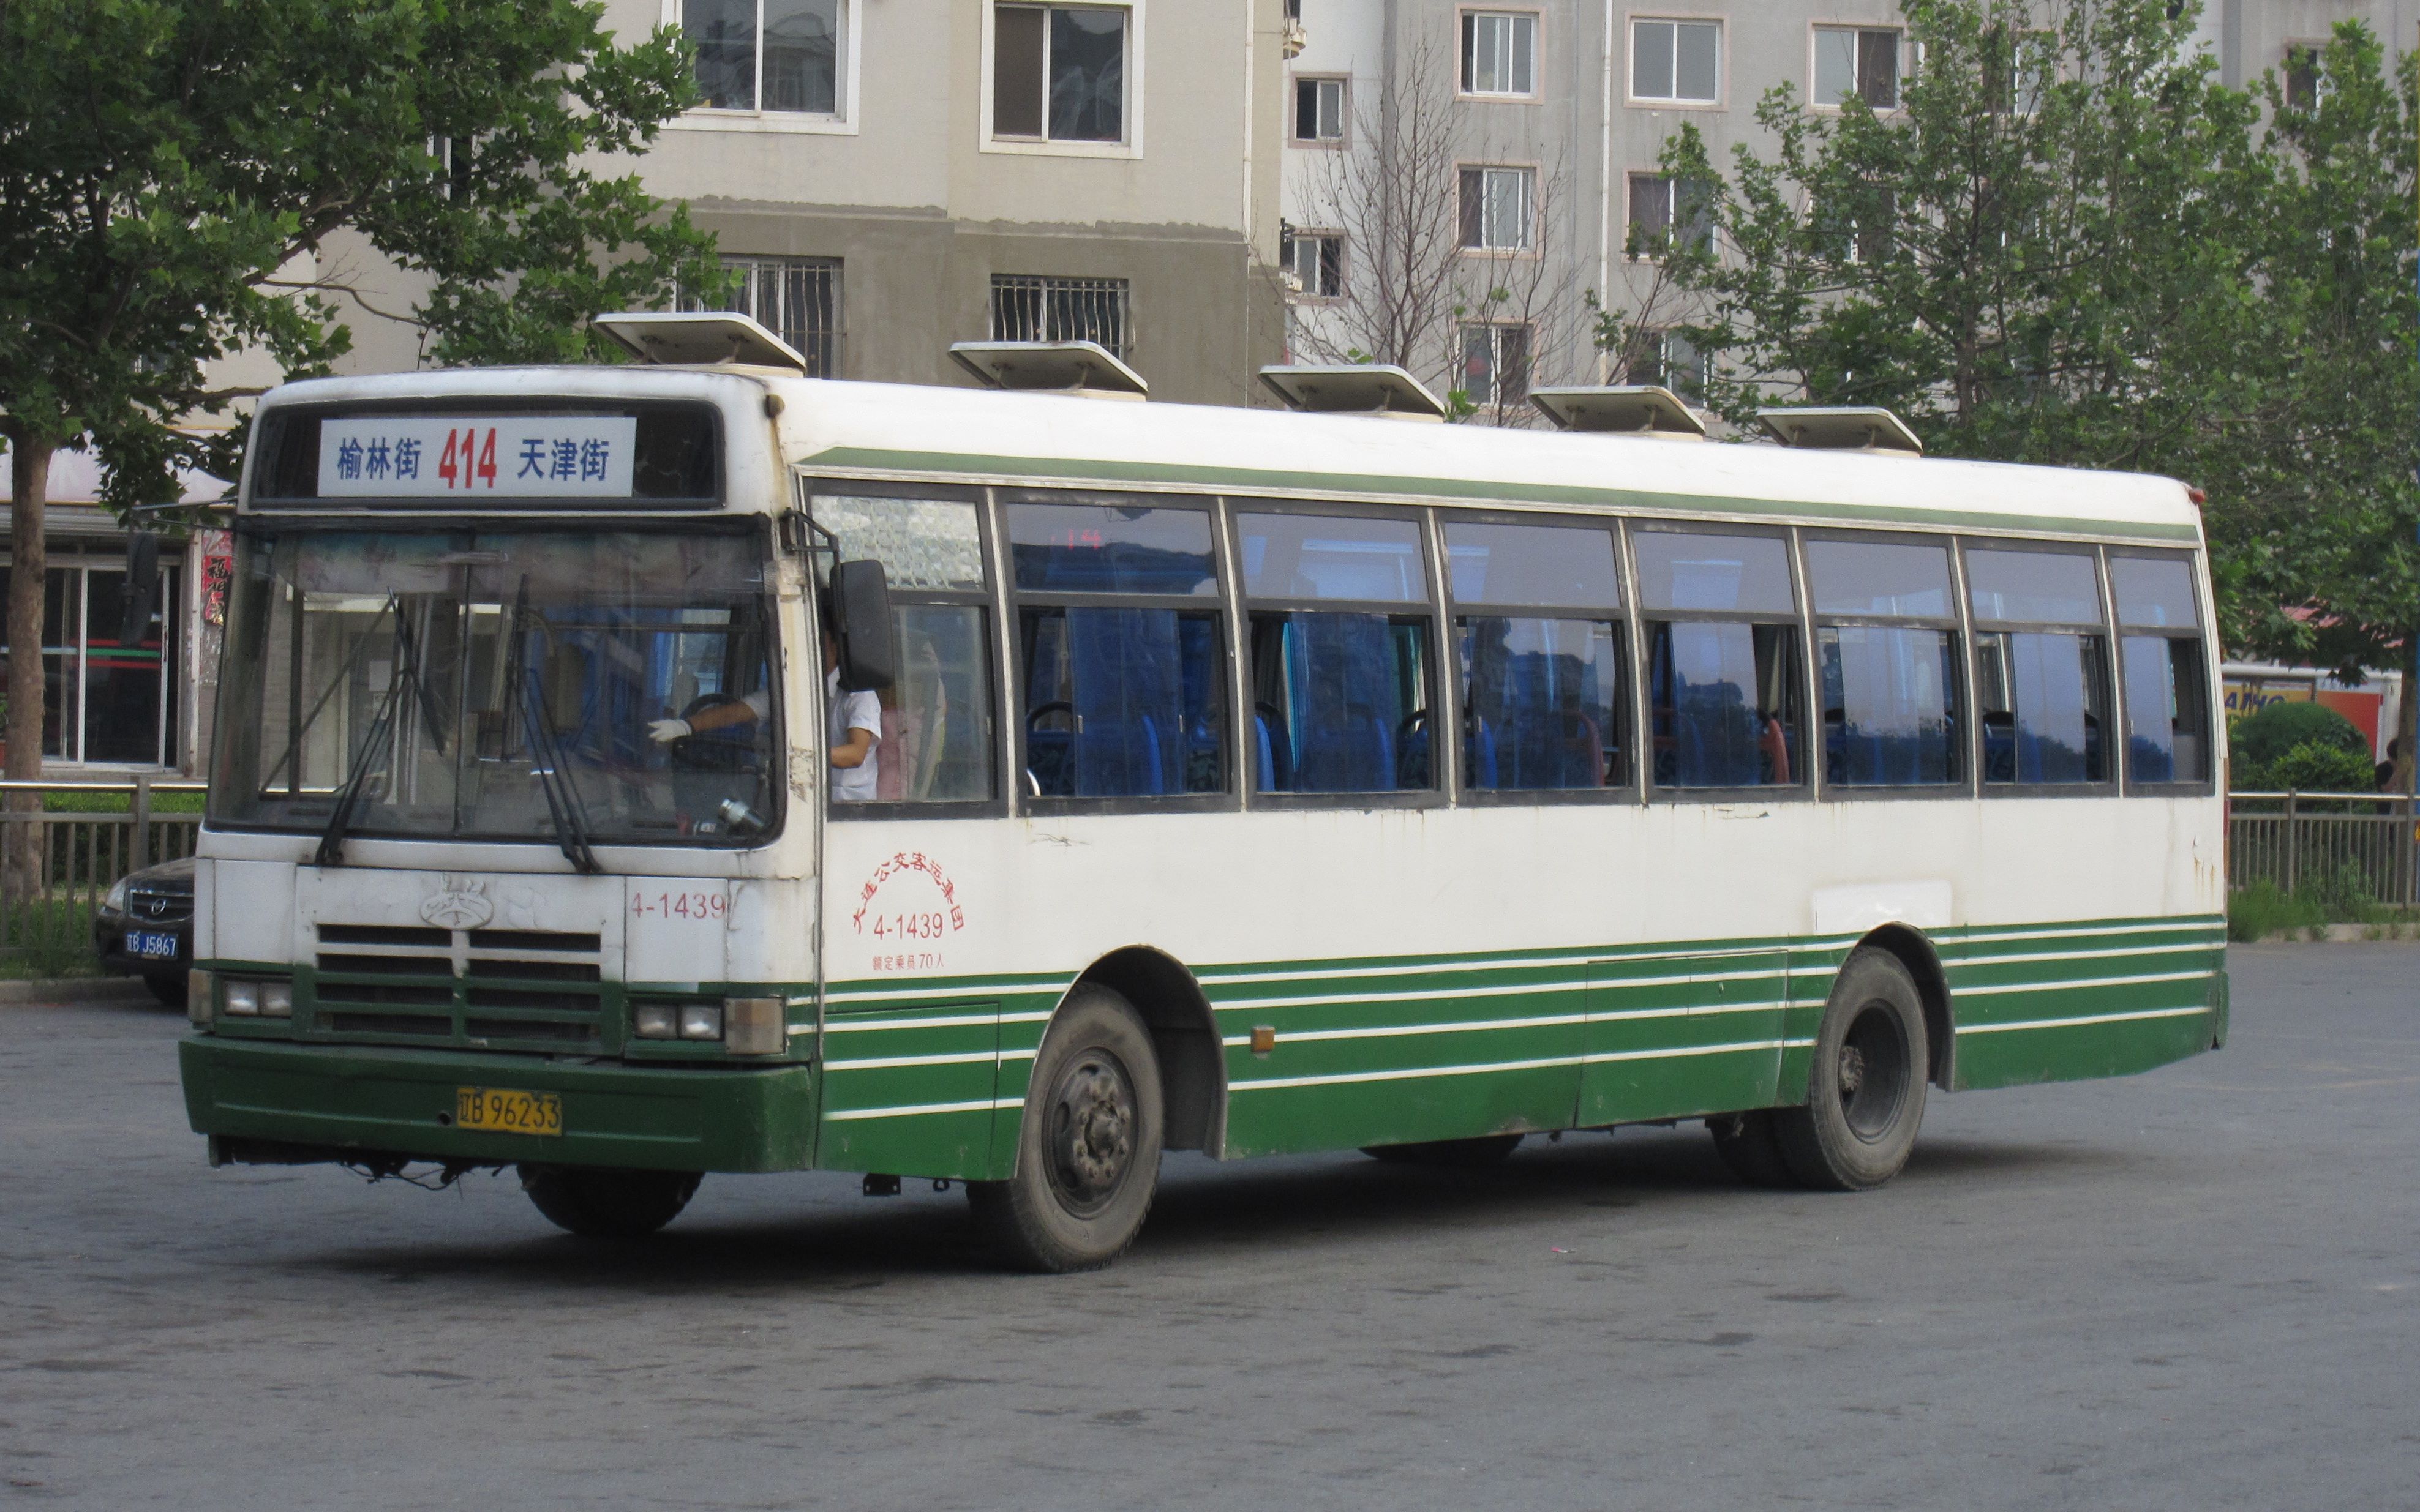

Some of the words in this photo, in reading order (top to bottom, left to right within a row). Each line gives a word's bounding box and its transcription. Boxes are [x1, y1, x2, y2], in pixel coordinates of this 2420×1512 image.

[337, 436, 422, 481] 榆林街
[438, 427, 497, 489] 414
[517, 438, 609, 481] 天津街
[632, 891, 726, 919] 4-1439
[852, 851, 964, 935] 大连公交客运集团
[873, 913, 943, 940] 4-1439
